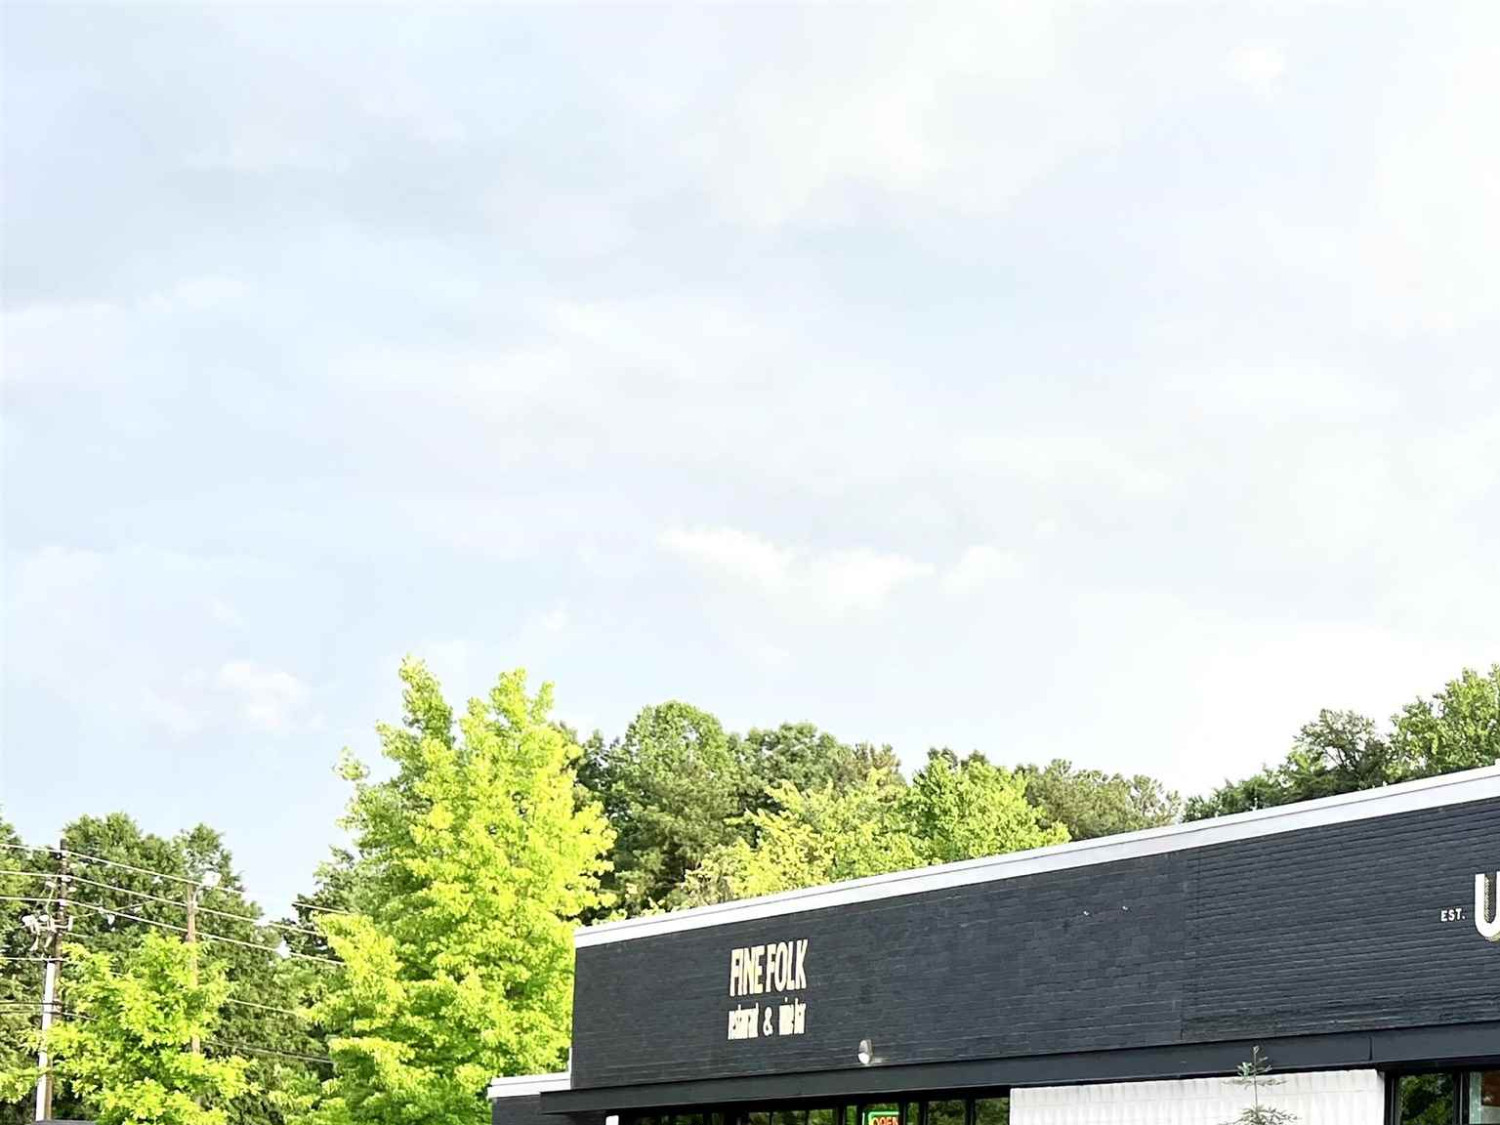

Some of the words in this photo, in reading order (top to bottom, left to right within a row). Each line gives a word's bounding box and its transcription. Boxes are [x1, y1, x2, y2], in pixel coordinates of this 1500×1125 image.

[1440, 908, 1466, 922] EST.
[729, 945, 766, 997] FINE
[765, 938, 809, 993] FOLK
[762, 1006, 774, 1037] &
